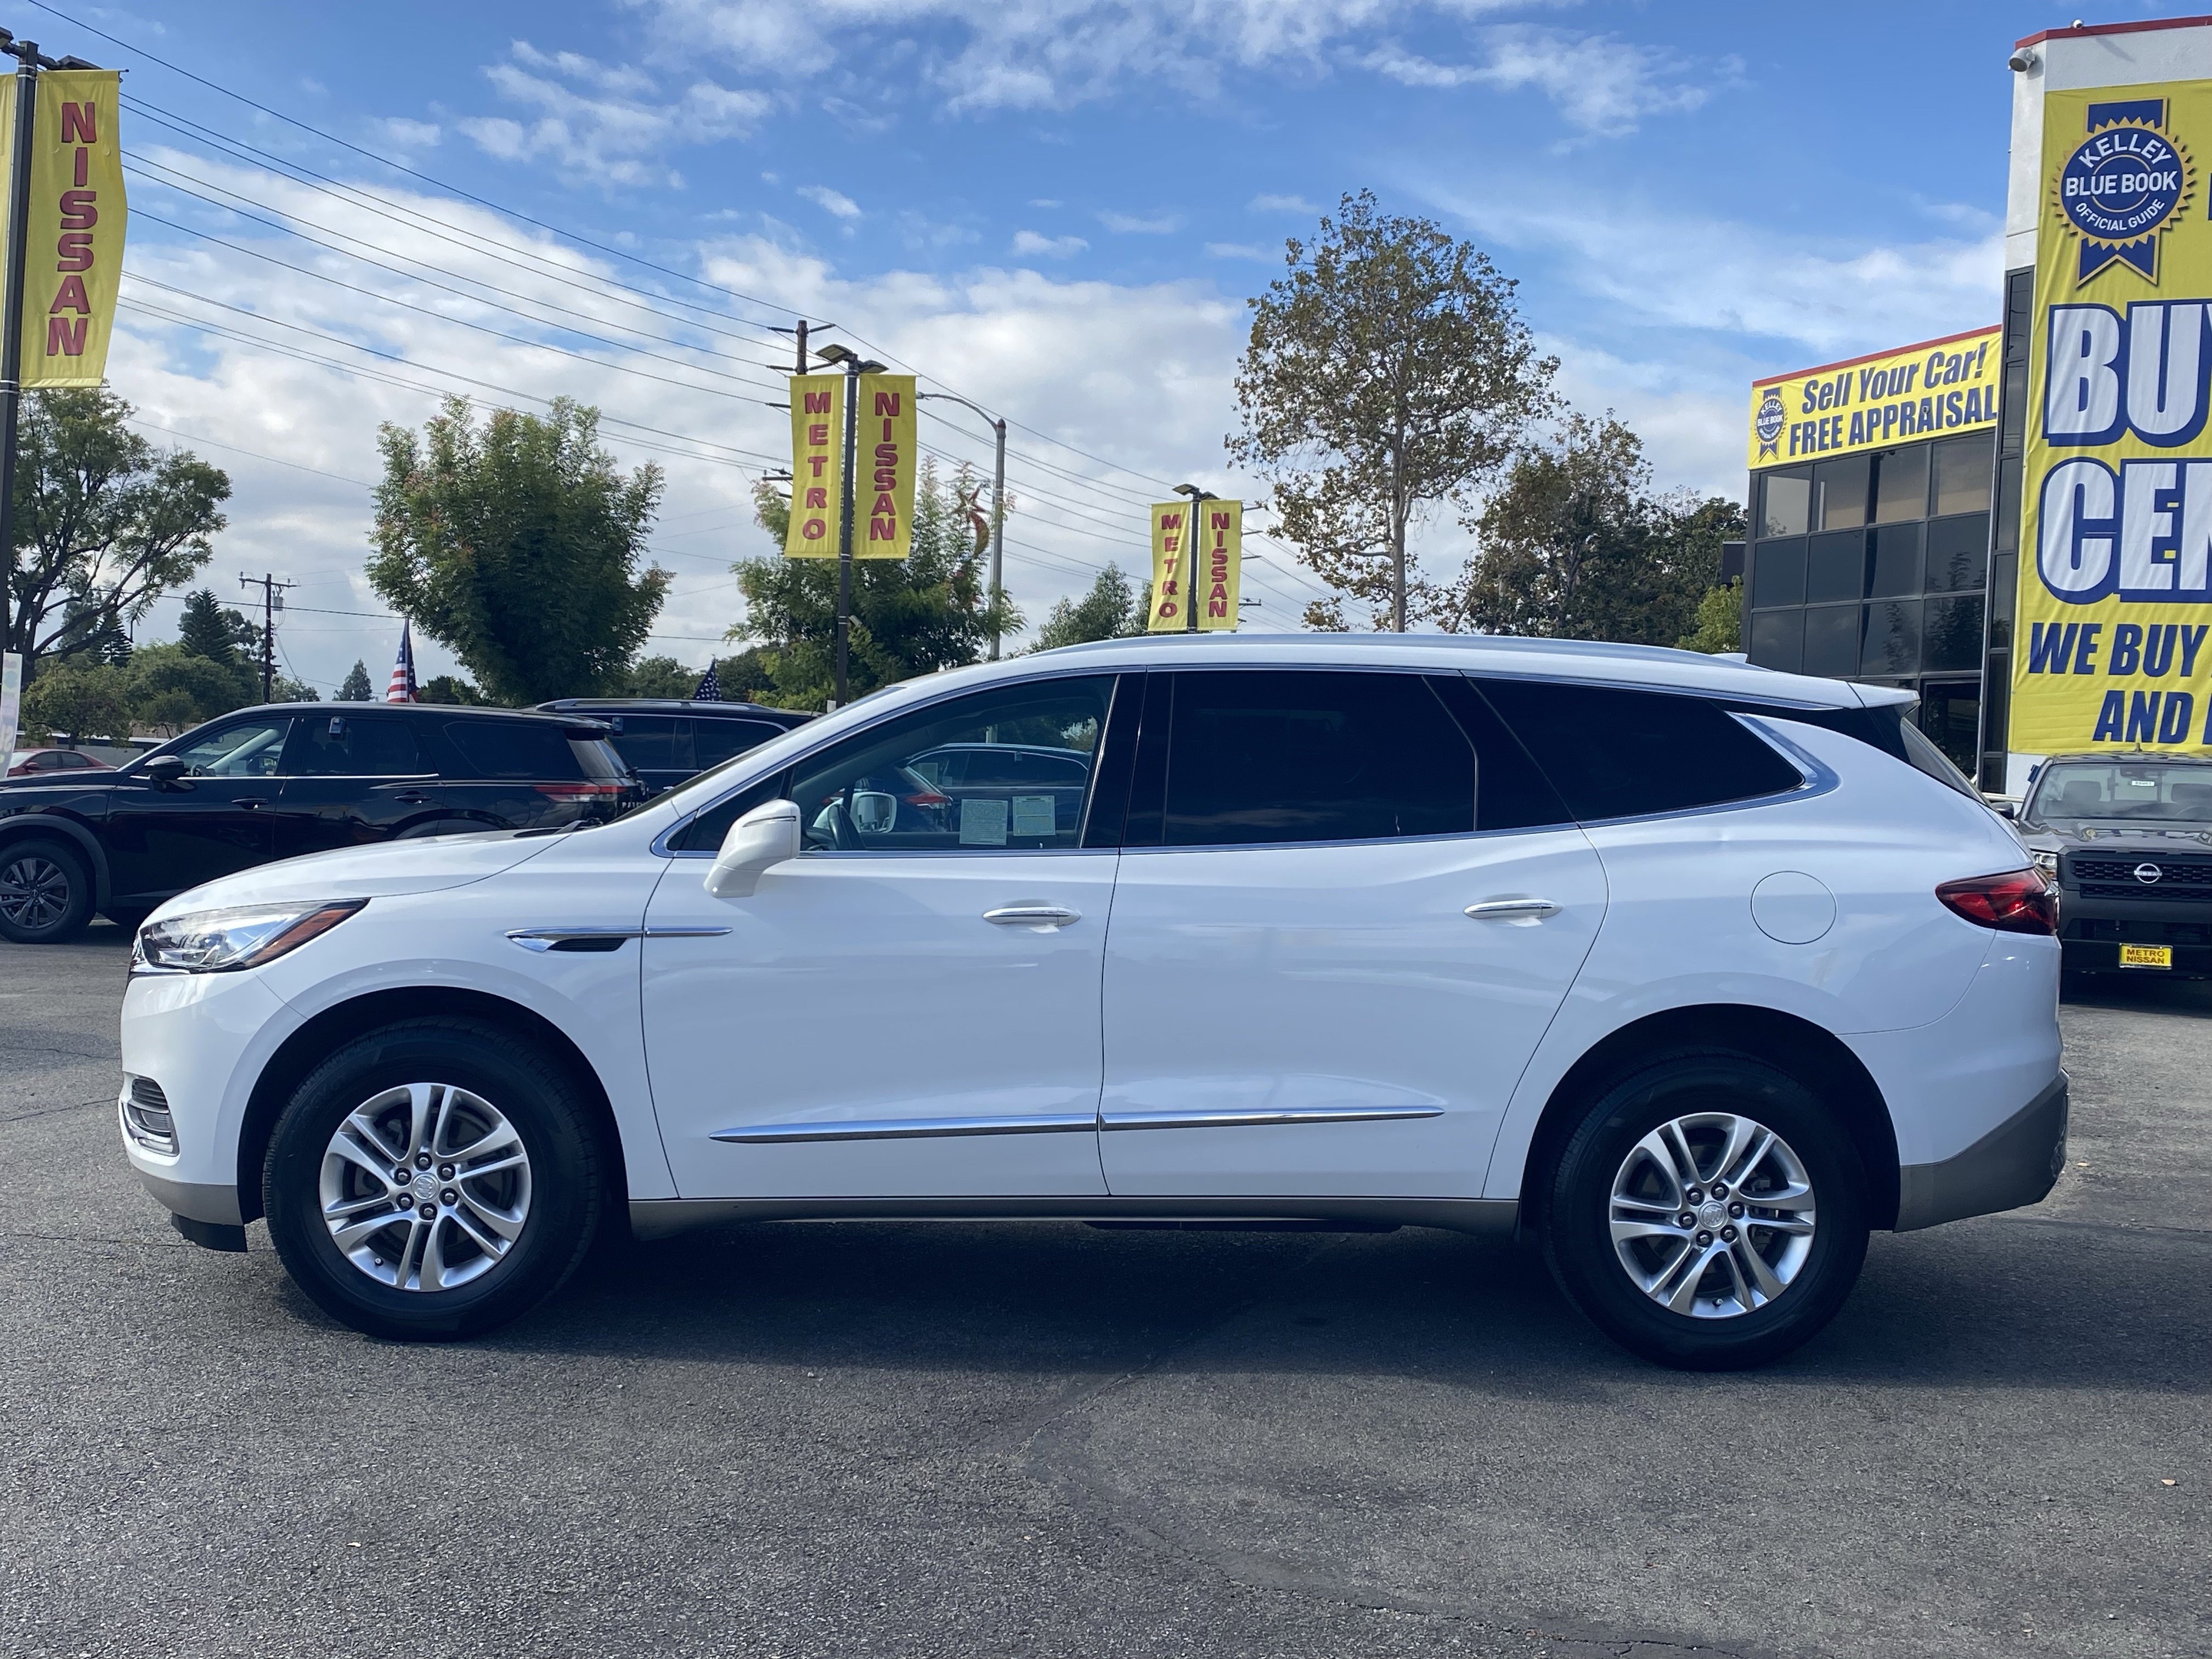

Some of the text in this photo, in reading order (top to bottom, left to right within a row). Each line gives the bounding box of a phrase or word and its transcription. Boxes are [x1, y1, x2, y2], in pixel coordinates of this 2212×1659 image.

[2079, 134, 2172, 168] KELLEY
[2066, 171, 2177, 196] BLUE BOOK
[46, 101, 99, 357] NISSAN
[2075, 198, 2165, 231] OFFICIAL GUIDE
[1802, 341, 1989, 414] Sell Your Car!
[2043, 300, 2212, 444] BU
[1757, 414, 1783, 426] BLUE BOOK
[1760, 400, 1782, 415] KELLEY
[1789, 385, 1997, 456] FREE APPRAISAL
[802, 391, 832, 540] METRO
[869, 392, 900, 541] NISSAN
[1159, 514, 1182, 618] METRO
[1209, 512, 1230, 618] NISSAN
[2028, 622, 2210, 678] WE BUY
[2092, 690, 2194, 743] AND
[2126, 949, 2165, 957] METRO
[2126, 956, 2165, 964] NISSAN
